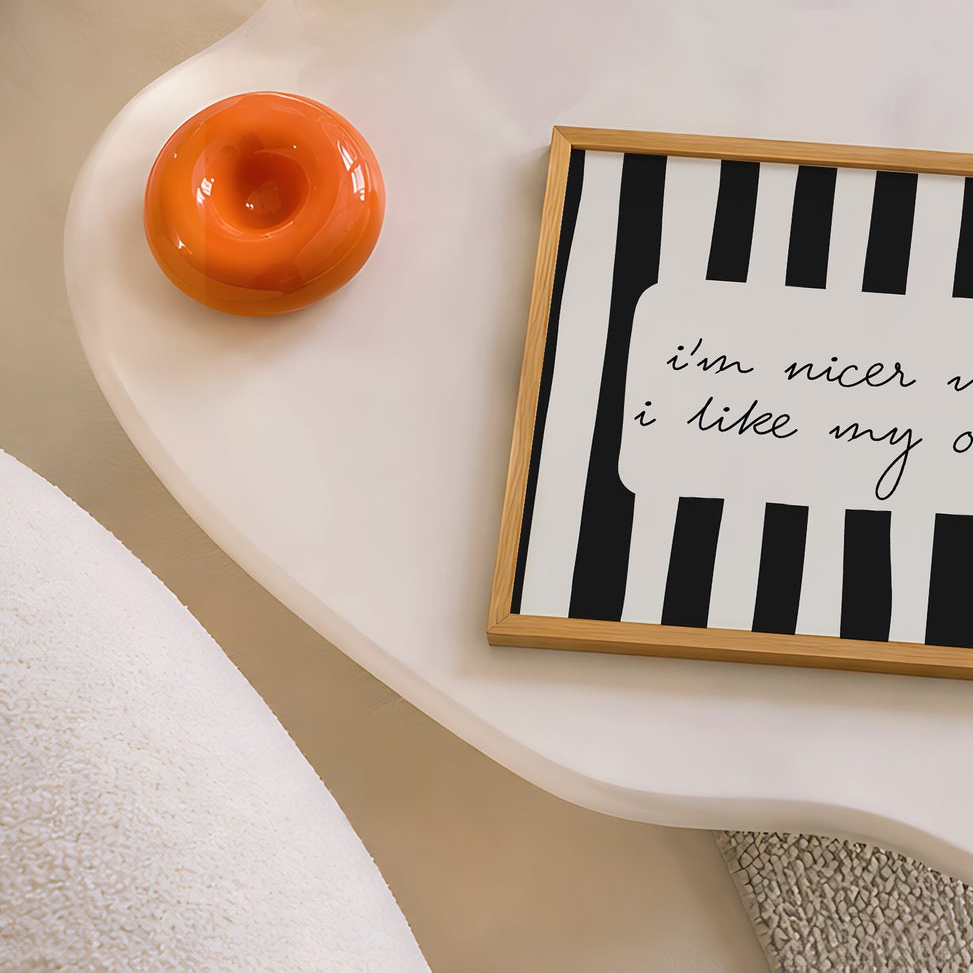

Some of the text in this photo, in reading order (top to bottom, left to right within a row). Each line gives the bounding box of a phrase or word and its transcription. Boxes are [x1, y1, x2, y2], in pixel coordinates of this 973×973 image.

[666, 338, 754, 374] i'm
[784, 356, 916, 388] nicer
[634, 401, 656, 426] i
[687, 396, 798, 438] like
[829, 422, 923, 500] my
